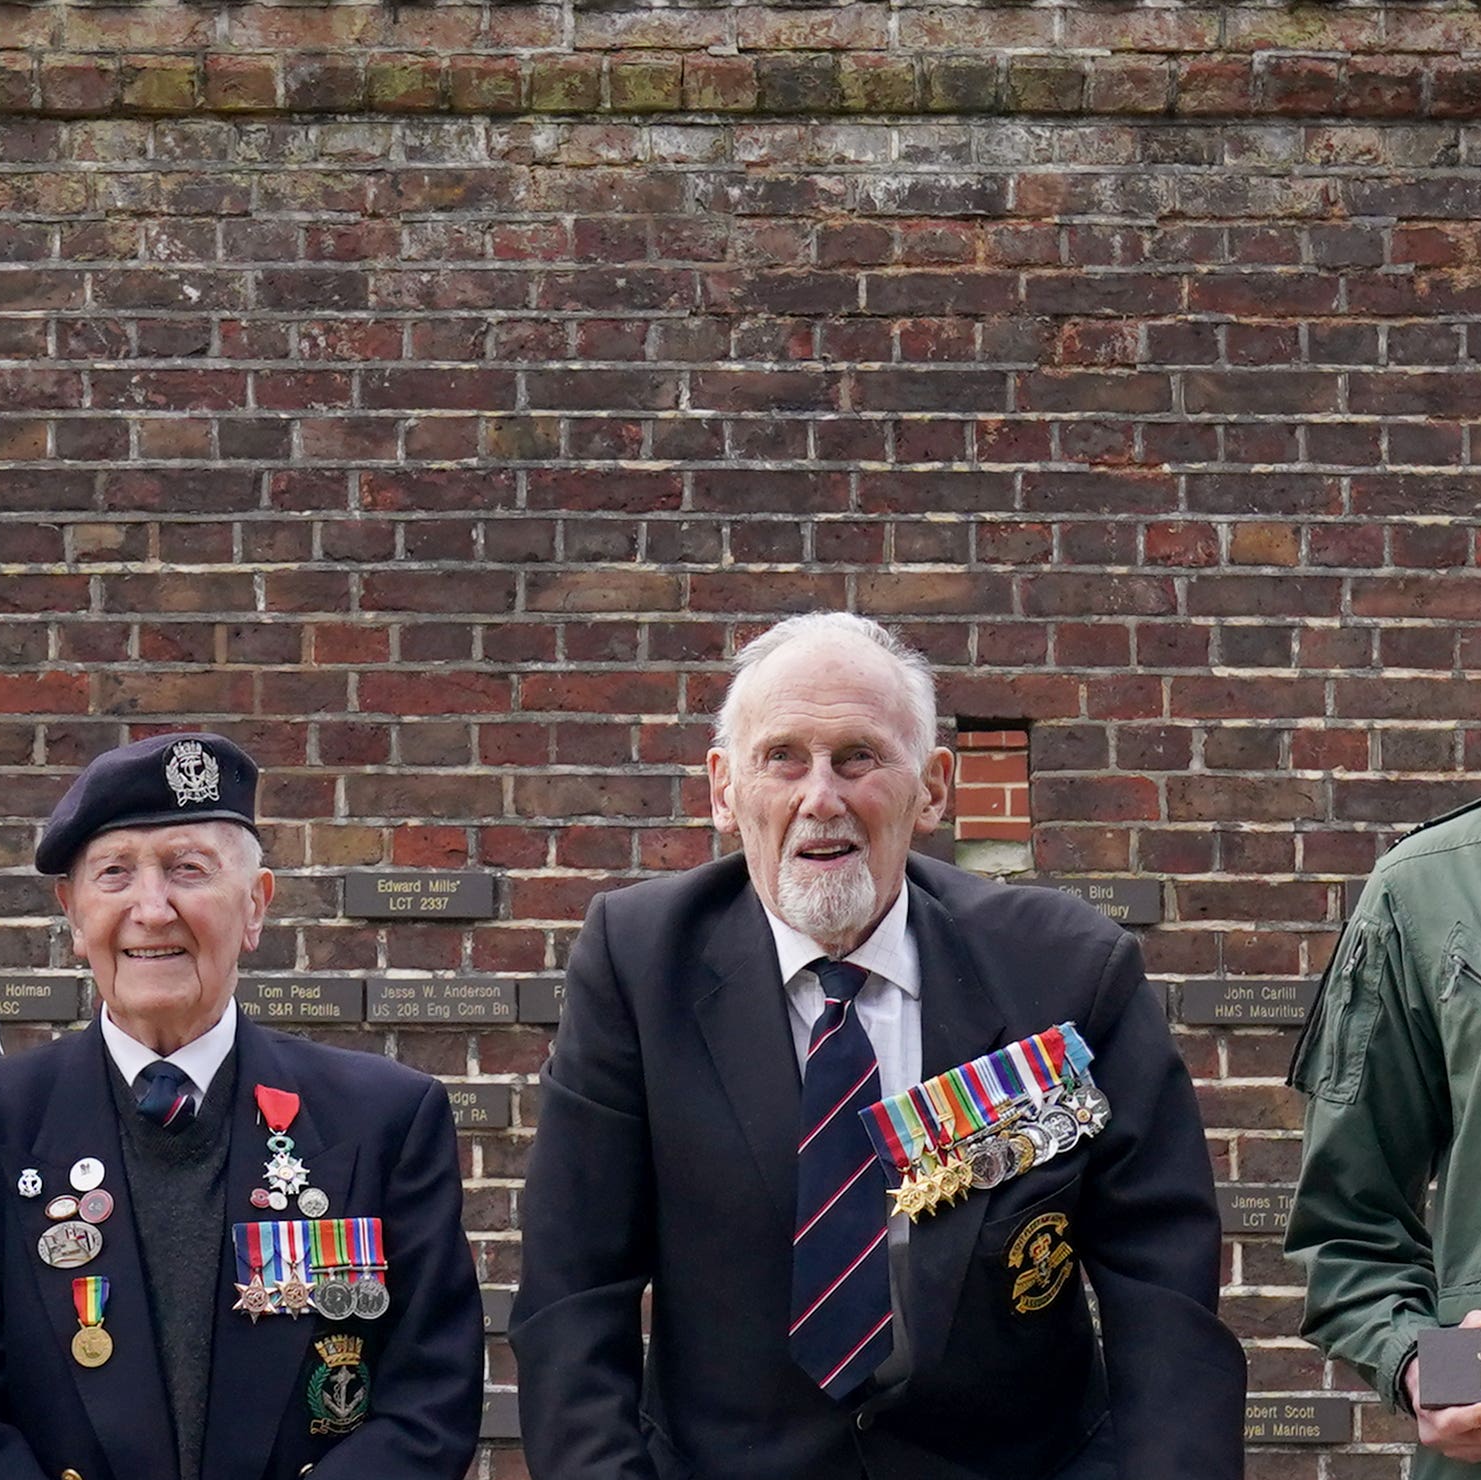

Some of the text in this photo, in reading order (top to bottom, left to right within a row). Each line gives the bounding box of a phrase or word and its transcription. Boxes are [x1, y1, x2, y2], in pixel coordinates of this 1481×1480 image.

[377, 879, 421, 893] Edward
[1089, 885, 1114, 899] Bird
[389, 897, 449, 910] LCT 2337
[5, 983, 51, 997] Holman
[257, 984, 321, 998] Tom Pead
[381, 985, 501, 999] Jesse W. Anderson
[1224, 986, 1297, 1000] John Carlill
[241, 1002, 341, 1017] 7th S&R Flotilla
[372, 1003, 390, 1017] US
[427, 1003, 451, 1018] Eng
[458, 1003, 486, 1016] Com
[492, 1002, 510, 1015] Bn
[1215, 1004, 1305, 1018] HMS Mauritius
[471, 1108, 488, 1122] RA
[1231, 1195, 1271, 1209] James
[1242, 1213, 1267, 1227] LCT
[1245, 1405, 1315, 1419] obert Scott
[1243, 1424, 1321, 1438] oyal Marines
